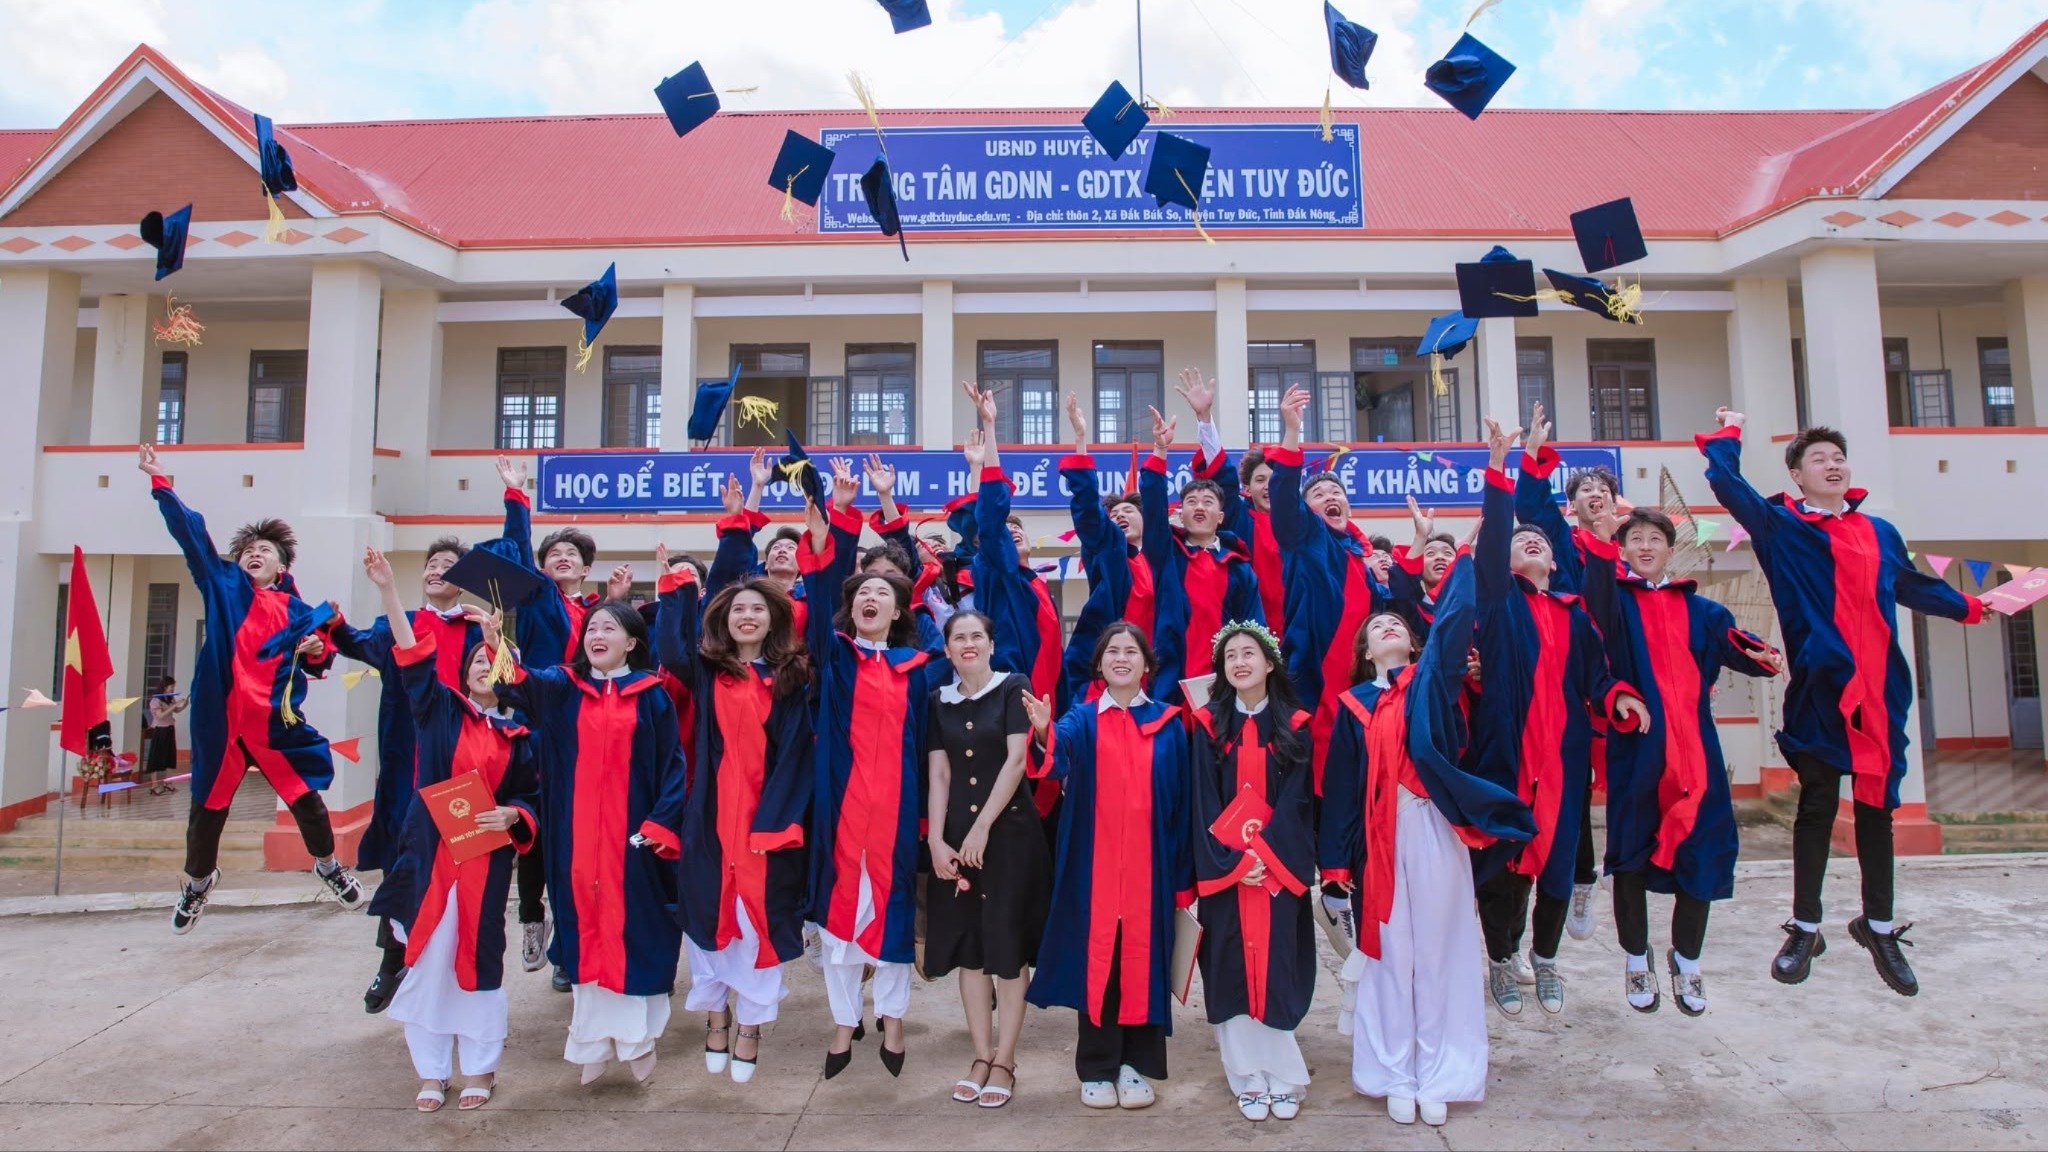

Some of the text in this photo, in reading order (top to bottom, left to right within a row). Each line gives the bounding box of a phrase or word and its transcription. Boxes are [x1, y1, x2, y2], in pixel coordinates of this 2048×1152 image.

[986, 139, 1037, 157] UBND
[1125, 139, 1149, 155] UY
[833, 172, 915, 202] TRG
[922, 164, 977, 201] TÂM
[985, 170, 1053, 201] GDNN
[1077, 169, 1142, 199] GDTX
[1241, 168, 1289, 198] TUY
[1297, 161, 1349, 198] ĐỨC
[1026, 210, 1043, 223] Địa
[1046, 209, 1063, 221] chỉ:
[1066, 209, 1089, 221] thôn
[1091, 209, 1101, 222] 2,
[1104, 209, 1117, 220] Xã
[1143, 208, 1163, 220] Búk
[1166, 209, 1181, 222] So,
[1217, 209, 1235, 221] Tuy
[1238, 208, 1260, 221] Đức,
[1263, 207, 1284, 220] Tỉnh
[1310, 208, 1335, 222] Nông
[555, 473, 608, 503] HỌC
[617, 460, 655, 498] ĐỂ
[663, 463, 724, 497] BIẾT
[863, 464, 920, 496] LM
[1013, 458, 1047, 496] ĐỂ
[1059, 471, 1140, 497] CUN
